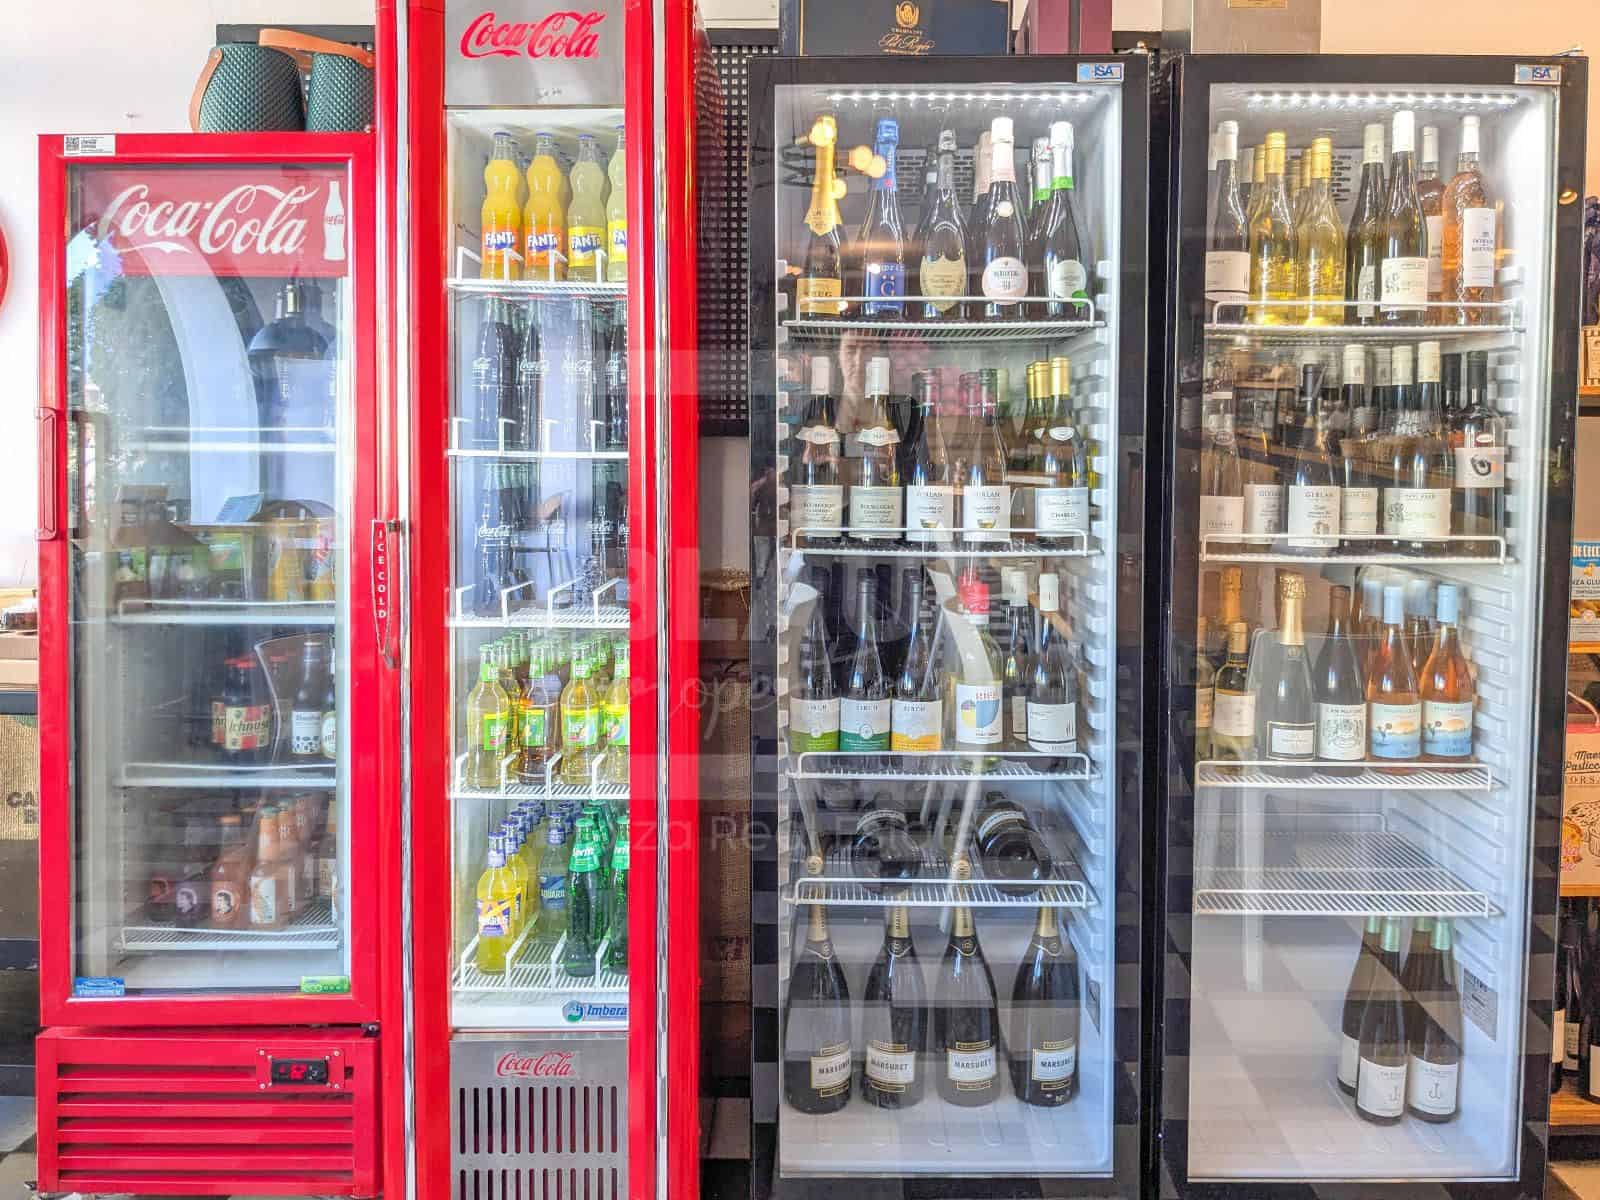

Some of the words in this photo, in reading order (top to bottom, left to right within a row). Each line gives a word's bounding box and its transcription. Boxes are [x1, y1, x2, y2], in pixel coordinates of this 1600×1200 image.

[1094, 64, 1114, 77] ISA
[100, 184, 320, 256] Coca-Cola
[377, 529, 385, 565] ICE
[377, 570, 386, 618] COLD
[496, 1050, 576, 1077] Coca-Cola
